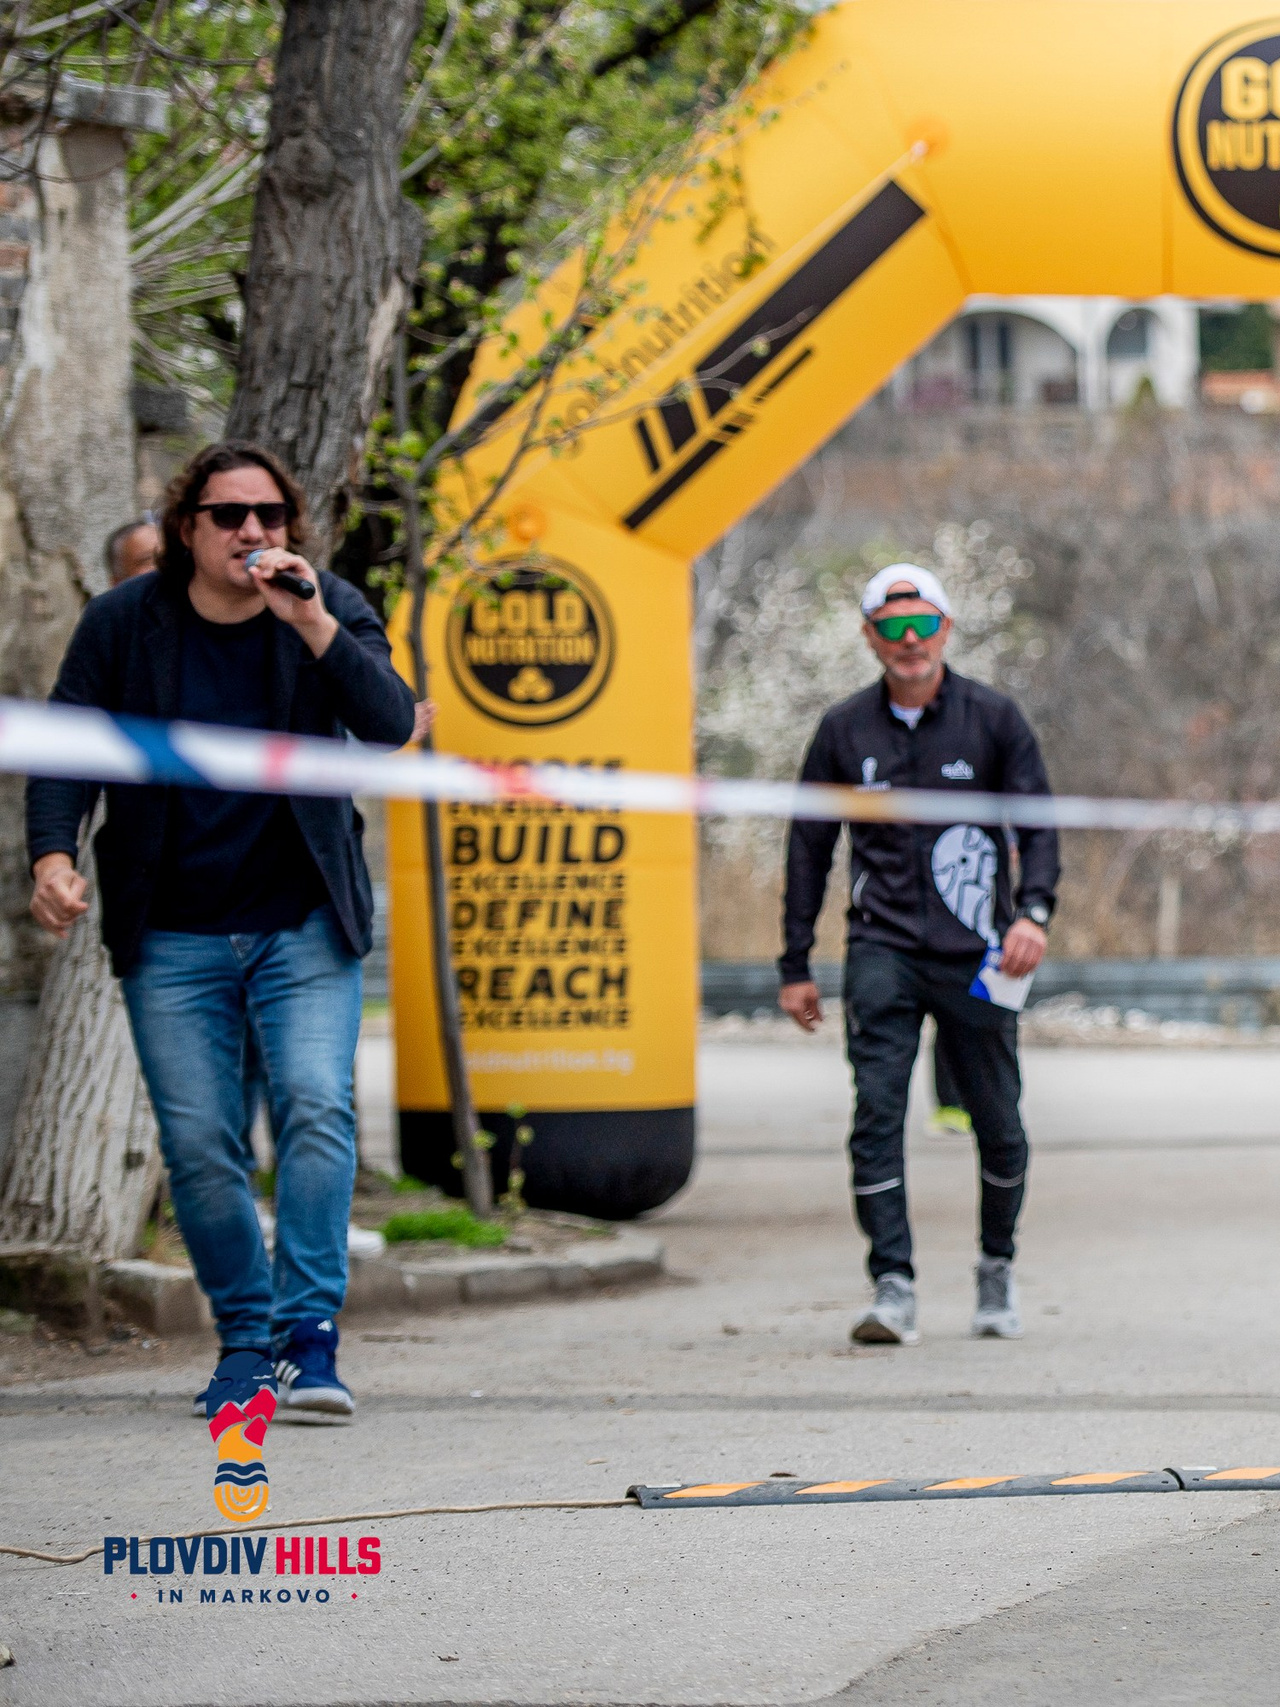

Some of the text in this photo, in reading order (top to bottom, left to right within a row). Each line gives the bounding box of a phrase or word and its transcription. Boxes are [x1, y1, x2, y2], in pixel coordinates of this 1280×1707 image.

[471, 589, 588, 636] GOLD
[452, 824, 626, 866] BUILD
[452, 898, 626, 931] DEFINE
[457, 965, 630, 1001] REACH
